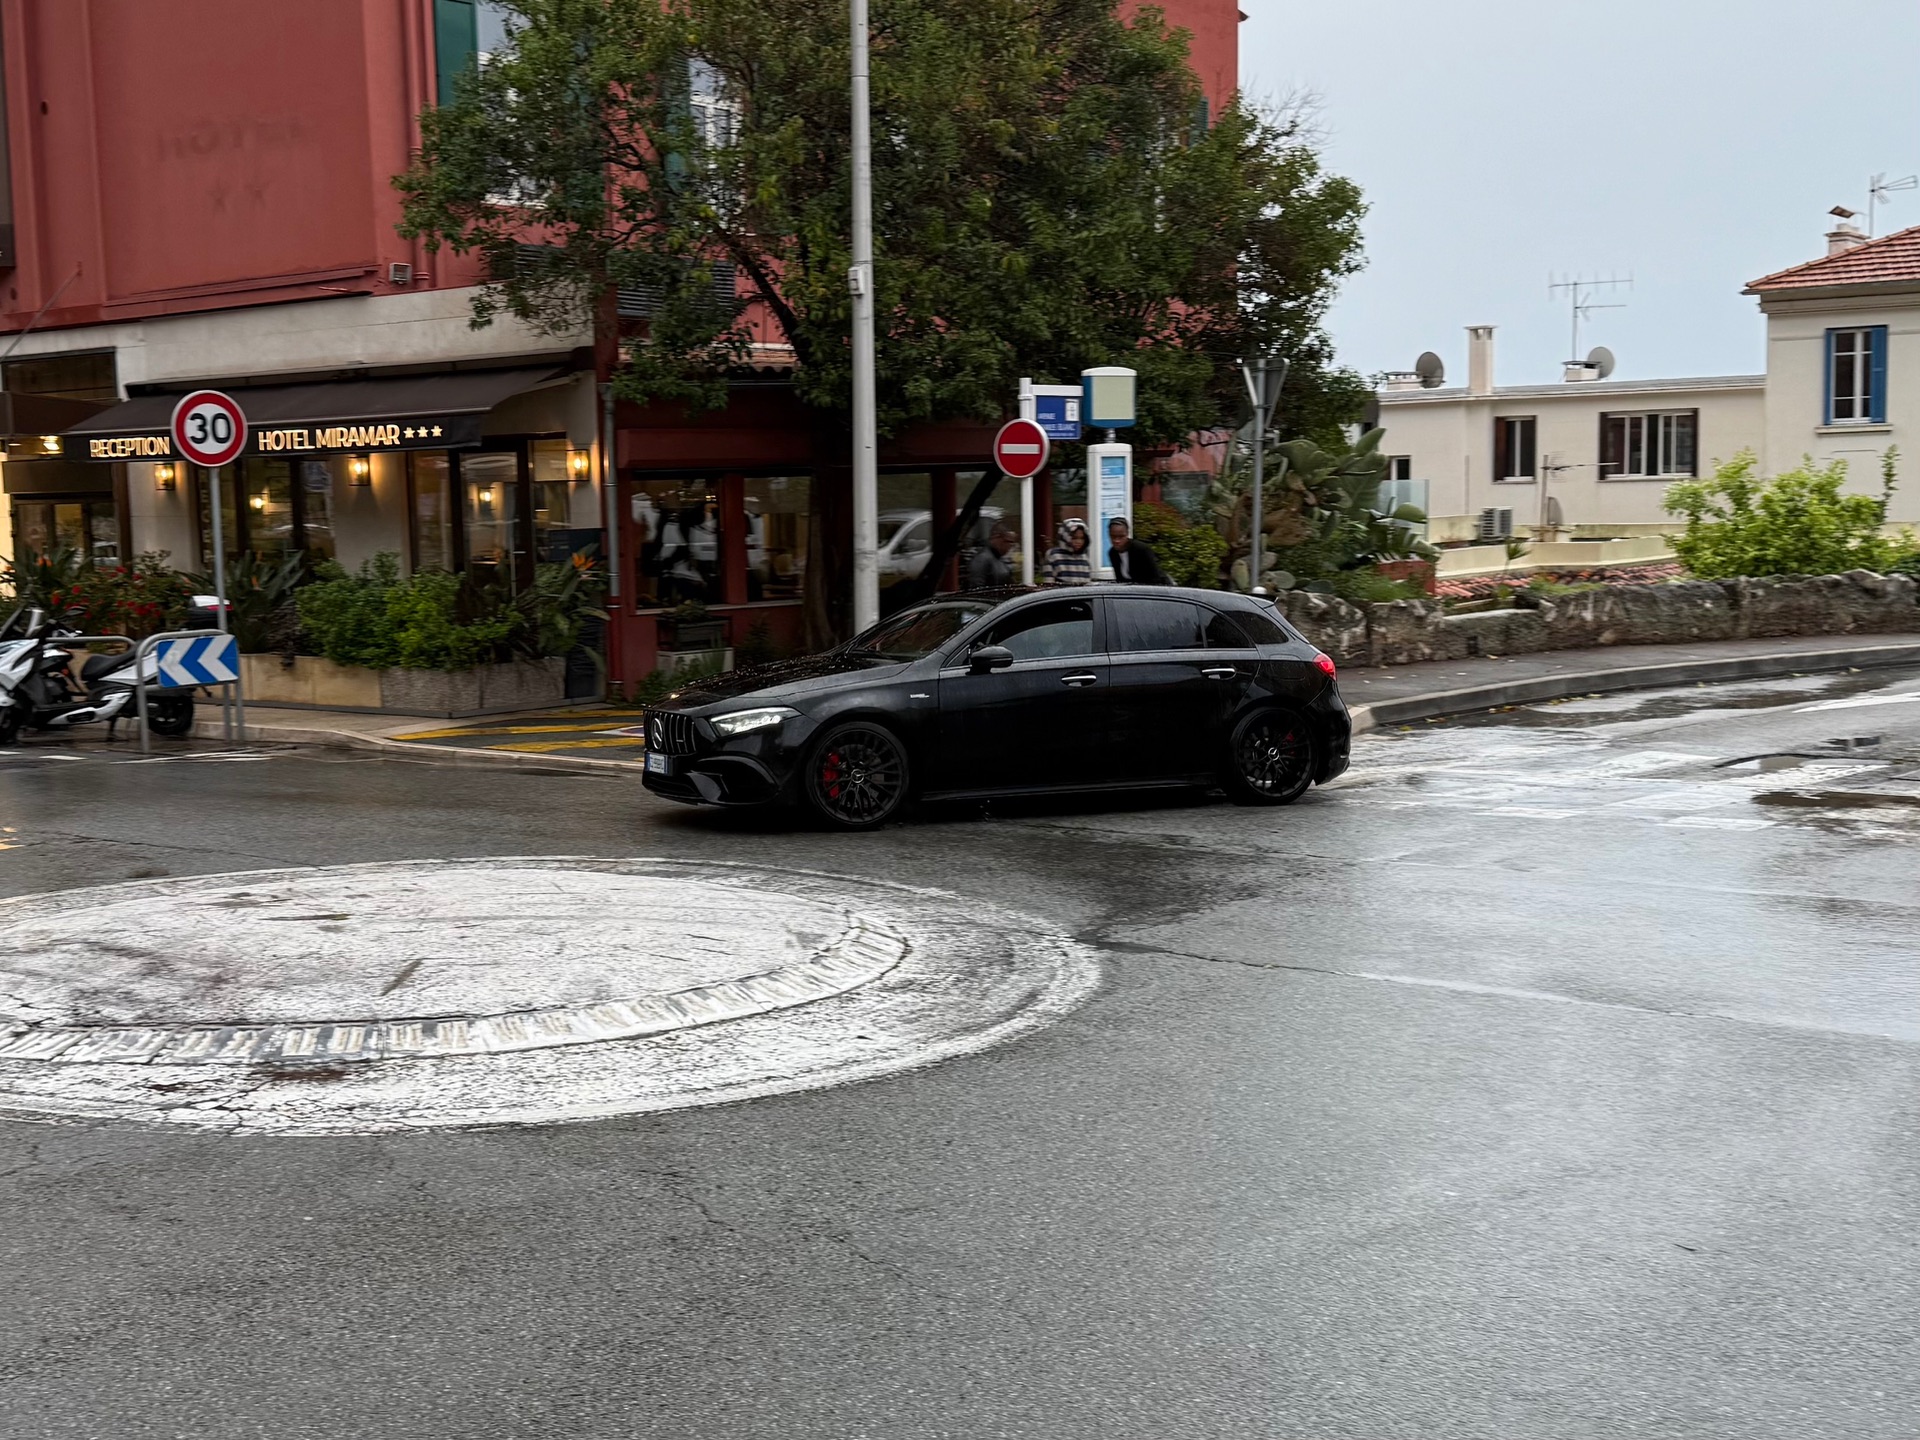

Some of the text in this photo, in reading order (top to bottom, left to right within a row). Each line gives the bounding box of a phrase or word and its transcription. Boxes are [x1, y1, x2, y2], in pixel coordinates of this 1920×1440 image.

[189, 413, 231, 444] 30
[258, 424, 400, 451] HOTEL MIRAMAR
[89, 436, 170, 458] RECEPTION
